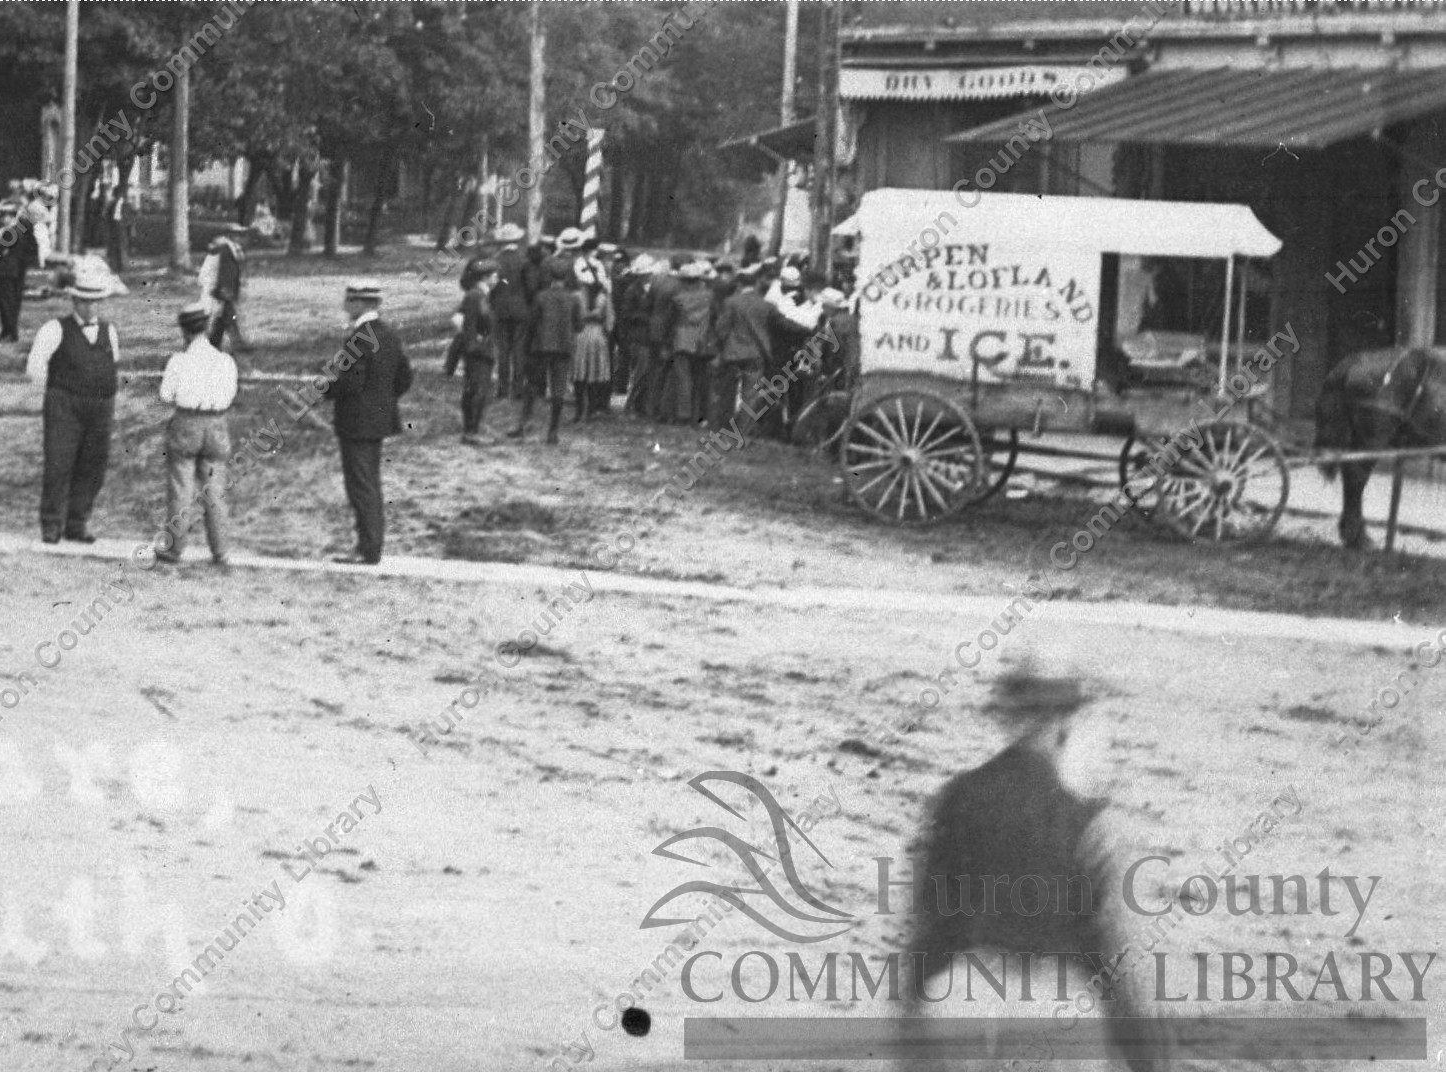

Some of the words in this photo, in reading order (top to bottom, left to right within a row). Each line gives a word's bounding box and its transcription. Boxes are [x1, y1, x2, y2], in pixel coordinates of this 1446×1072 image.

[885, 74, 932, 91] DRY
[958, 70, 1058, 89] GOODS
[947, 265, 1094, 324] LOFLAND
[874, 331, 931, 353] AND
